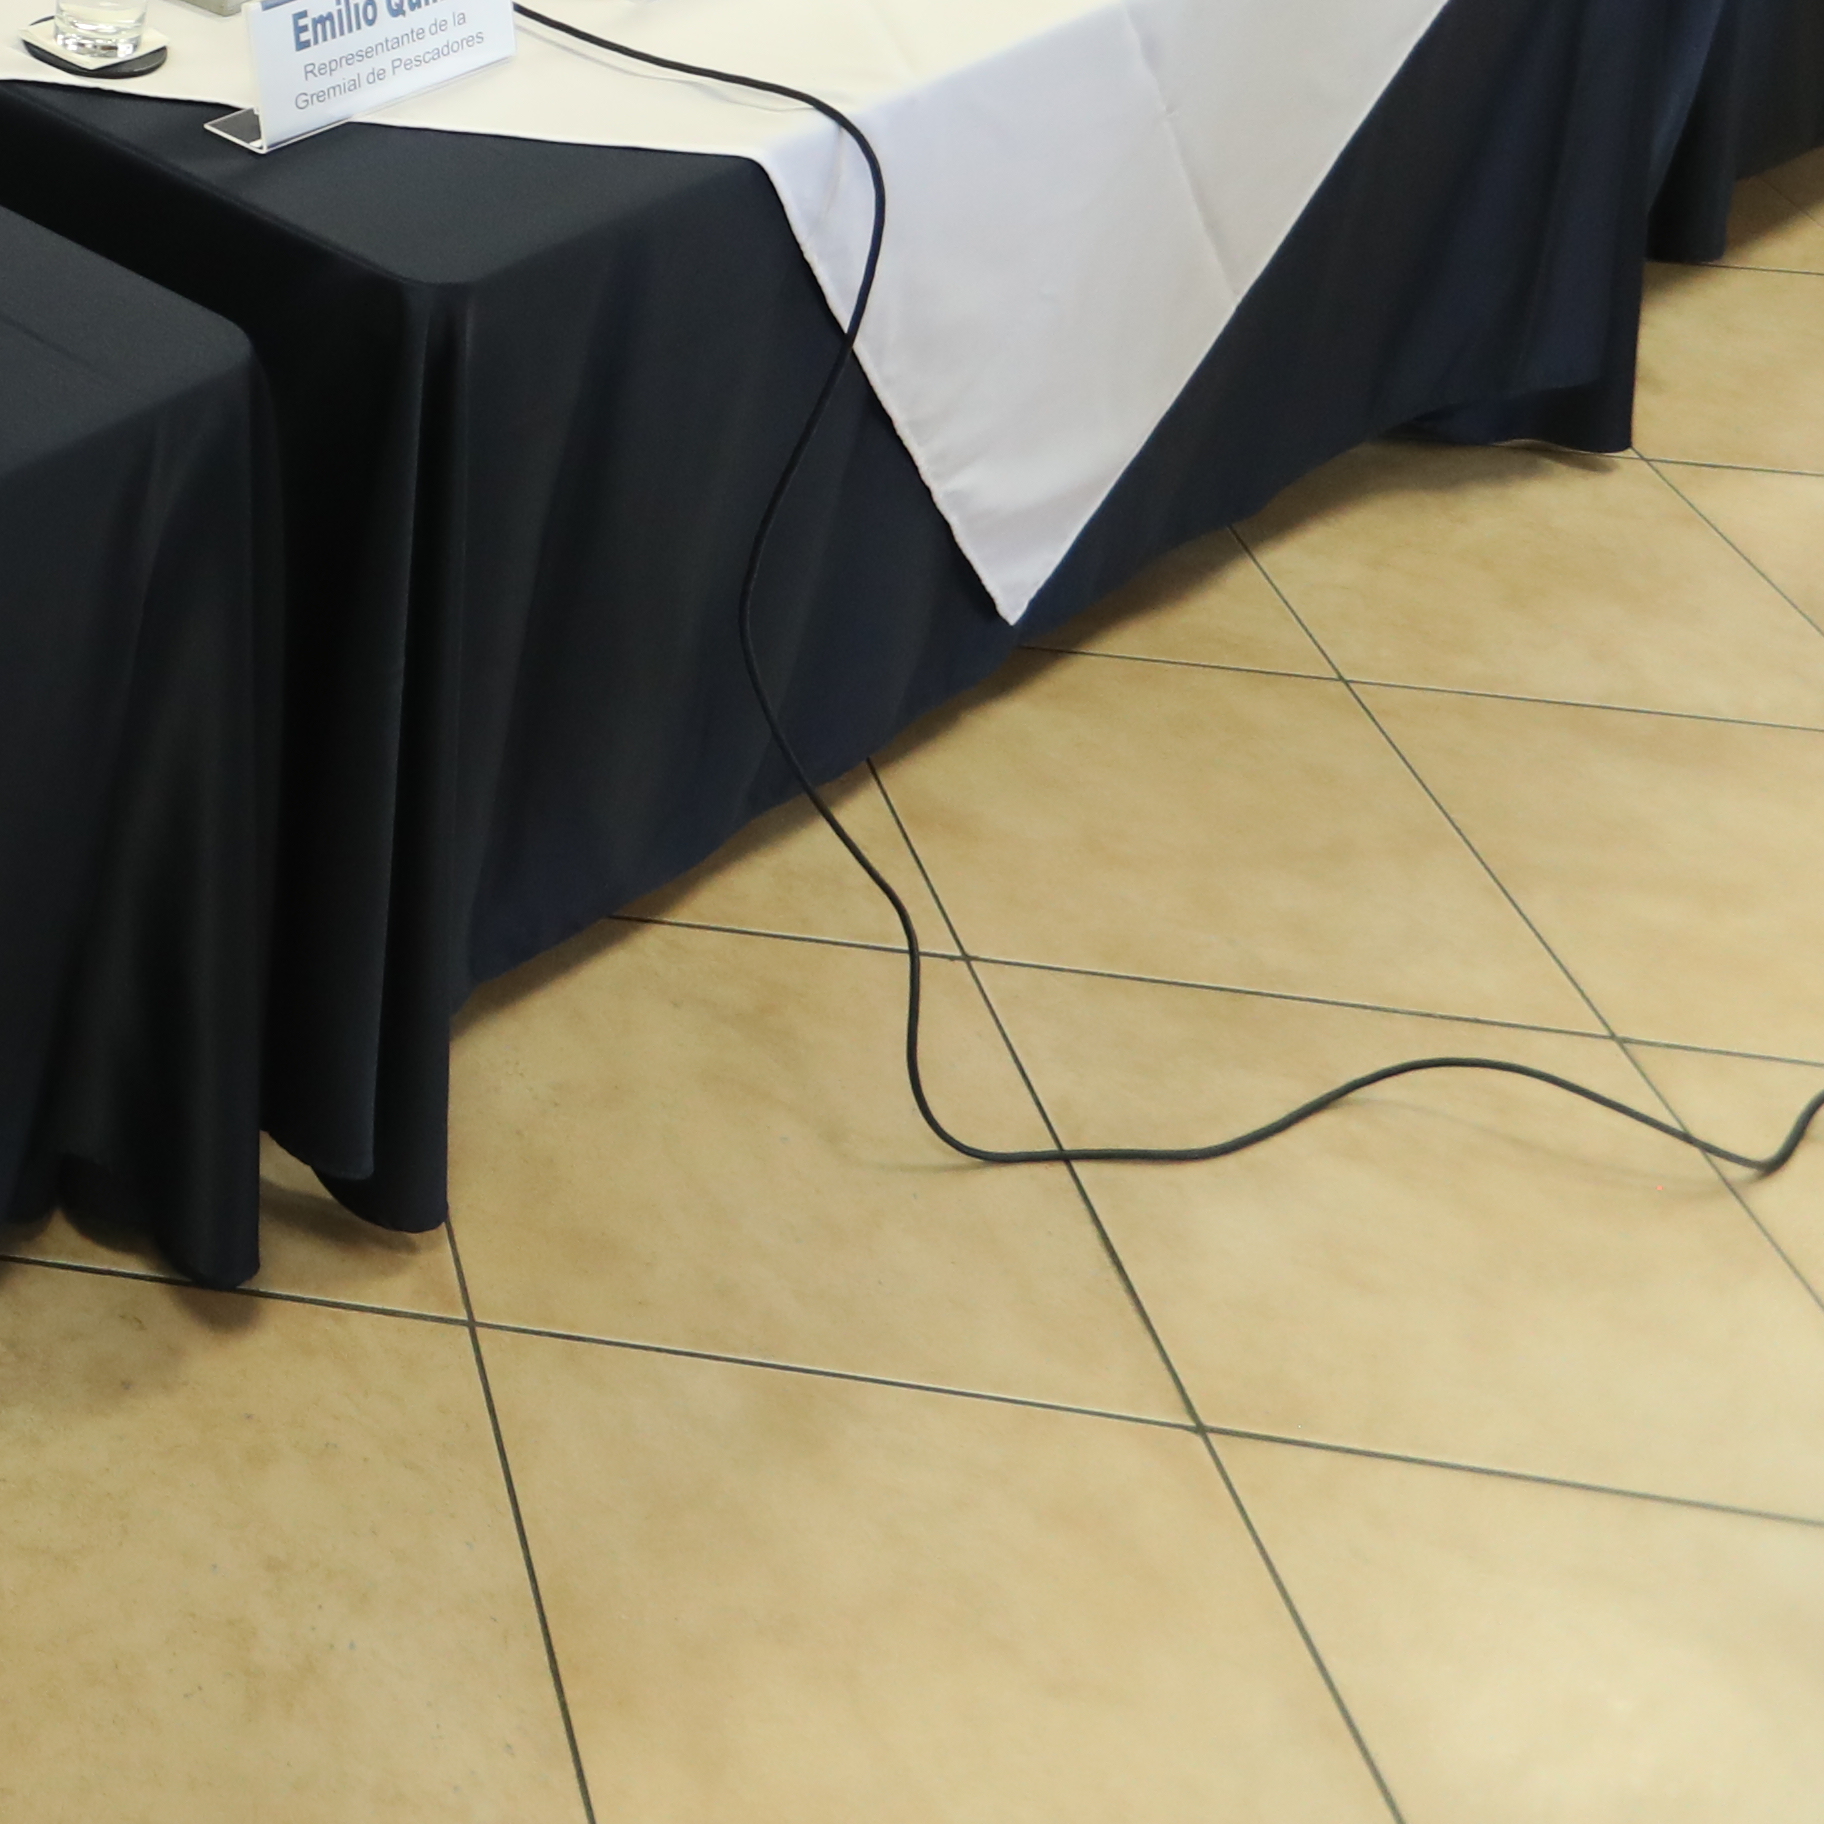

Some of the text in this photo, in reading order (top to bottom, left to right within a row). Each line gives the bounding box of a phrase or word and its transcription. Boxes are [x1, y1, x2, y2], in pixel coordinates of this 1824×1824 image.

[294, 30, 485, 111] Gremial de Pescadores
[303, 10, 467, 81] Representante de la
